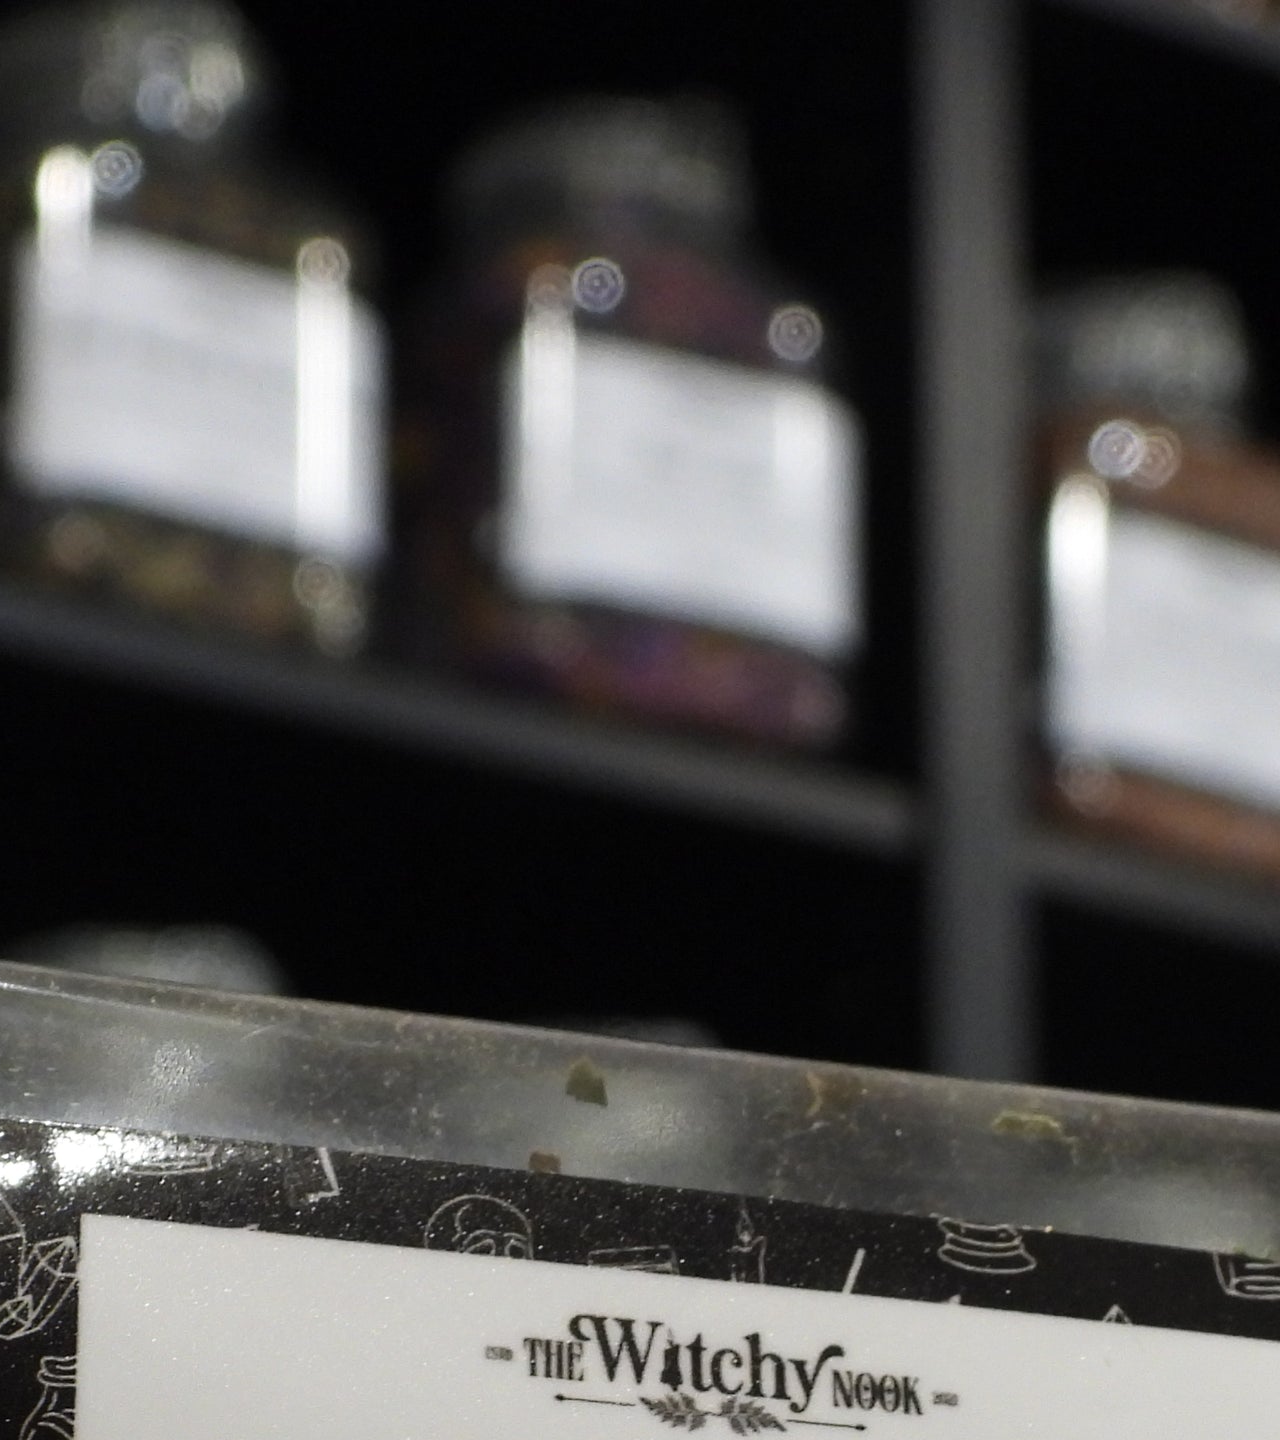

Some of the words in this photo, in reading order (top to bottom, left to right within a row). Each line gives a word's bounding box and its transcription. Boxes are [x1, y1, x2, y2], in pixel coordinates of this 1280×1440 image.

[523, 1337, 584, 1382] THE
[570, 1314, 845, 1414] Witchy
[831, 1369, 924, 1416] NOOK
